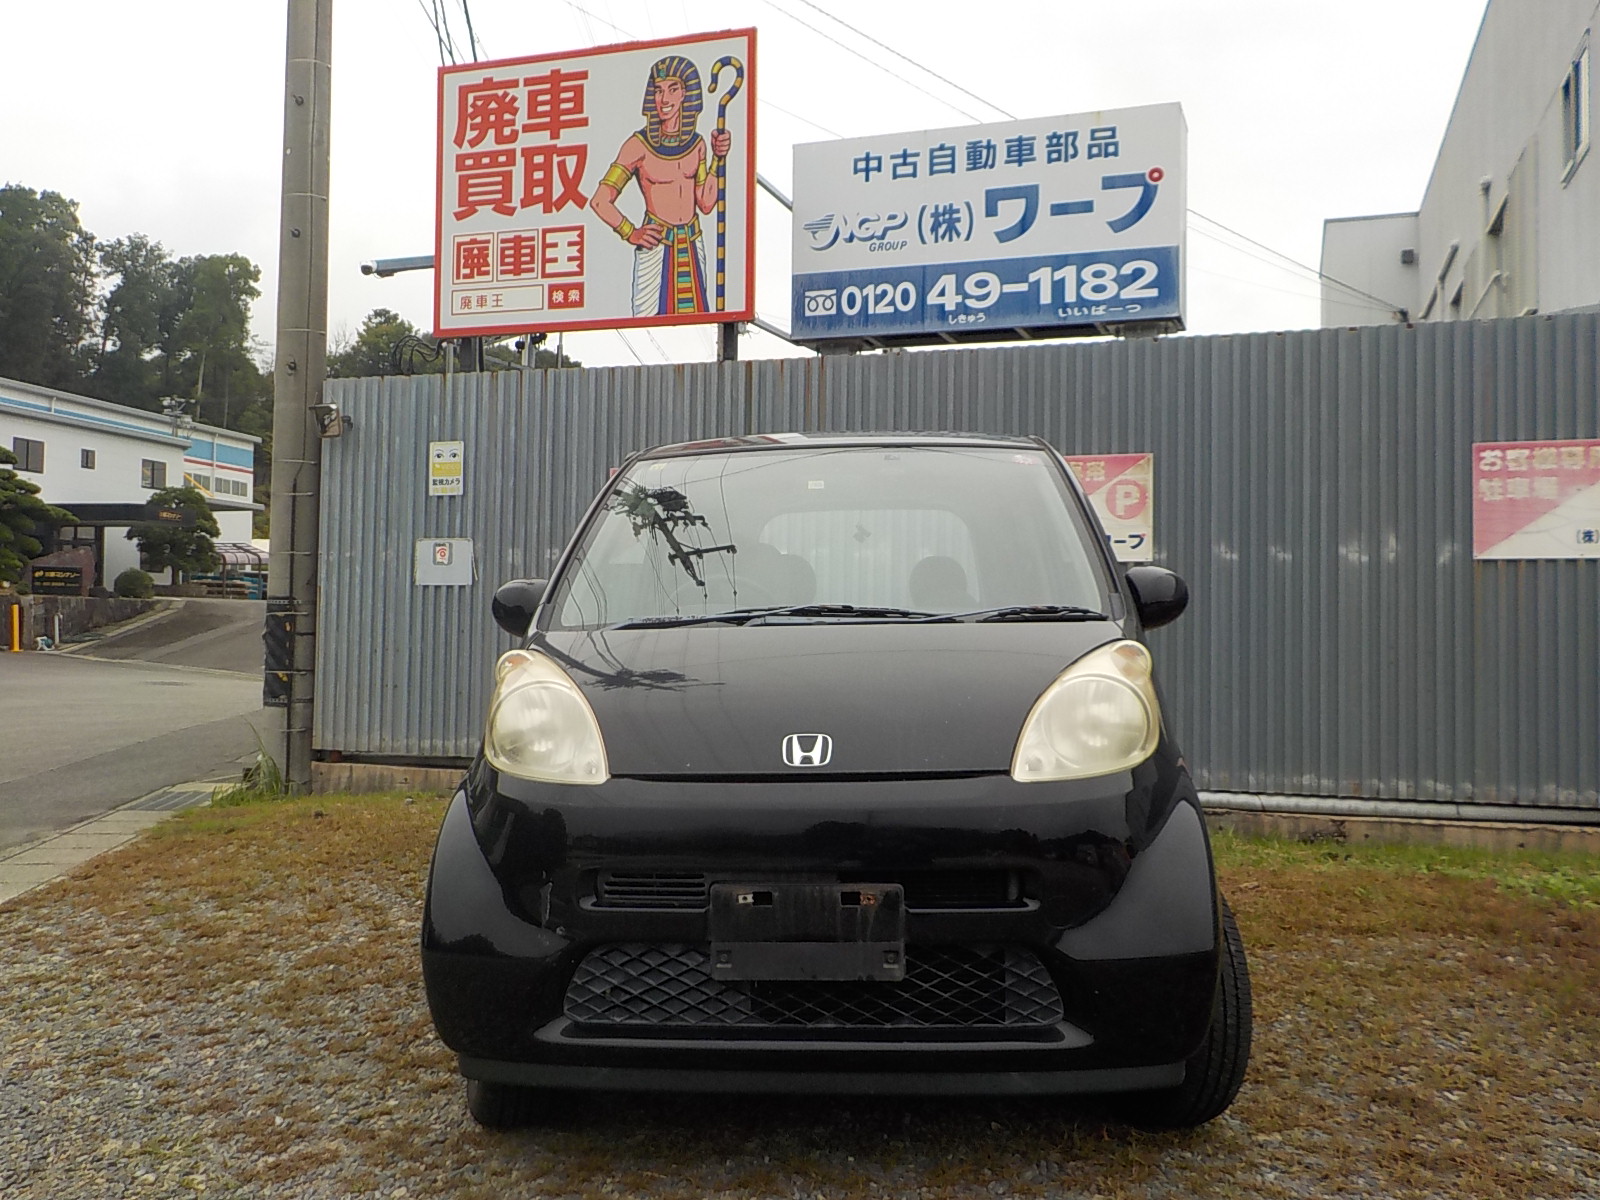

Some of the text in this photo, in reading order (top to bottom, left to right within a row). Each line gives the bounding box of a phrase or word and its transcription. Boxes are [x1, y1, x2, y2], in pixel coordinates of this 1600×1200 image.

[453, 68, 589, 149] 廃車
[853, 126, 1120, 182] 中古自動車部品
[453, 144, 589, 221] 買取
[869, 240, 908, 253] GROUP
[460, 293, 504, 310] 廃車王
[552, 289, 580, 304] 検索
[841, 260, 1160, 316] 0120 49-1182
[948, 312, 986, 324] しきゅう
